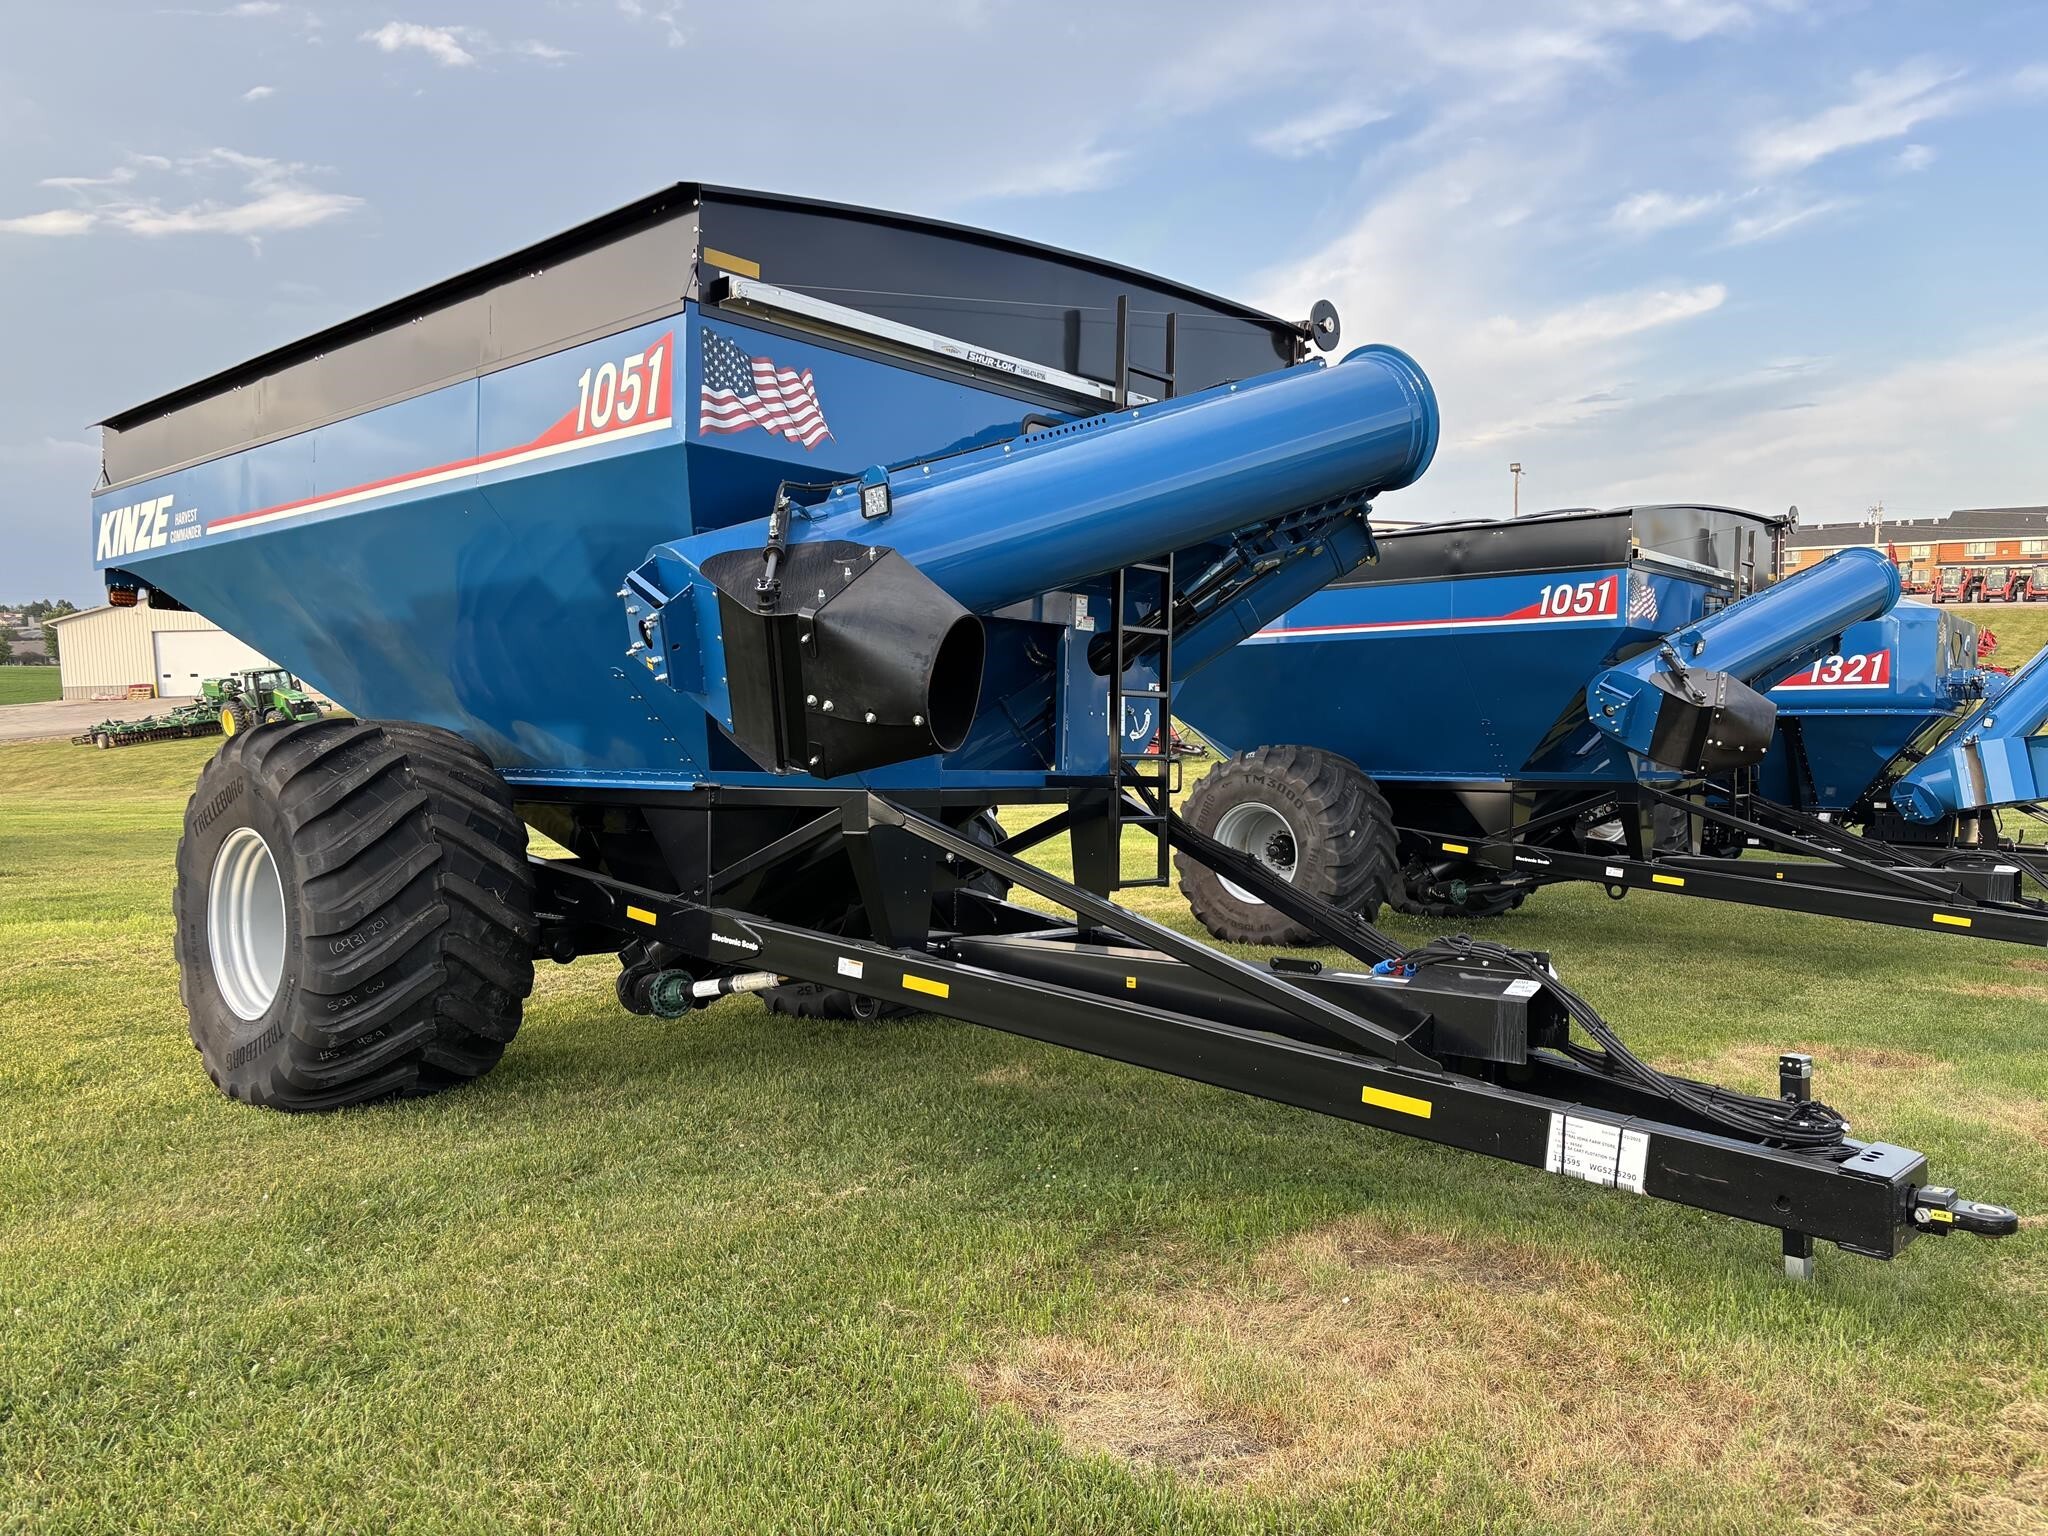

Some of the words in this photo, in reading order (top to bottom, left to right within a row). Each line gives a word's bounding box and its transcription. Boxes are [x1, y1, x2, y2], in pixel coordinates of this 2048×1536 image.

[576, 346, 664, 433] 1051
[96, 494, 174, 562] KINZE
[170, 525, 202, 544] COMMANDER
[174, 508, 198, 526] HARVEST
[1539, 580, 1611, 616] 1051
[1810, 653, 1884, 683] 1321
[192, 776, 244, 837] TRELLEBORG
[226, 1019, 284, 1072] TRELLEBORG
